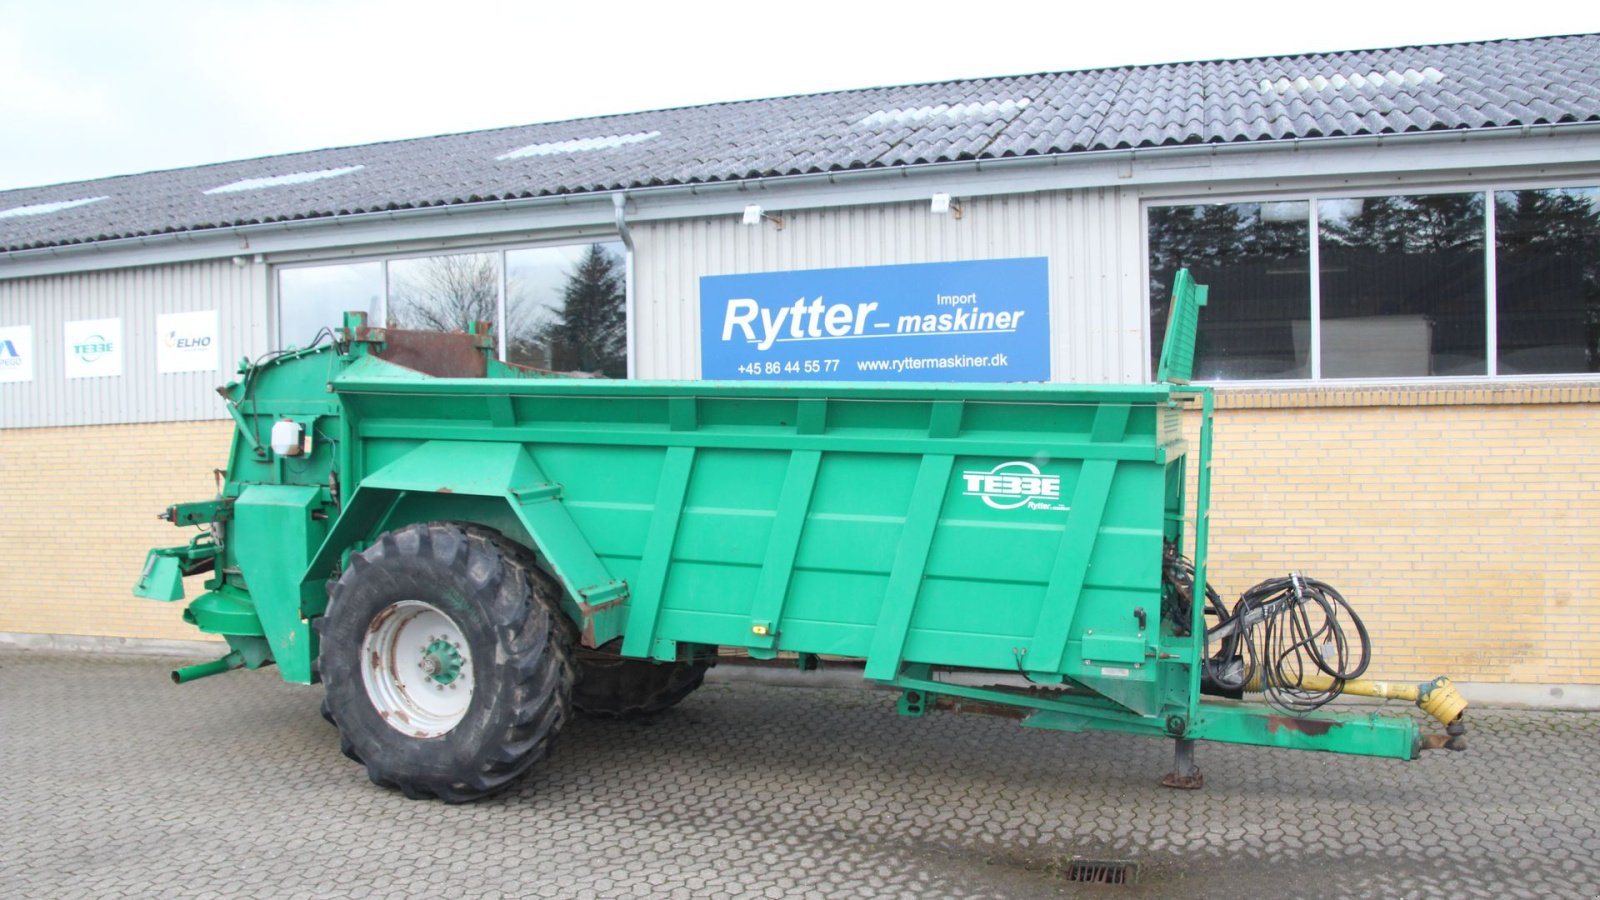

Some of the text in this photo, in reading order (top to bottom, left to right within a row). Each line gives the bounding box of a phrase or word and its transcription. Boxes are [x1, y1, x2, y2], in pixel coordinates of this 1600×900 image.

[937, 293, 976, 307] Import
[897, 307, 1025, 333] maskiner
[73, 342, 113, 354] TEBBE
[176, 337, 211, 348] ELHO
[737, 353, 1008, 375] +45 86 44 55 77 www.ryttermaskiner.dk
[963, 474, 1060, 497] TEBBE
